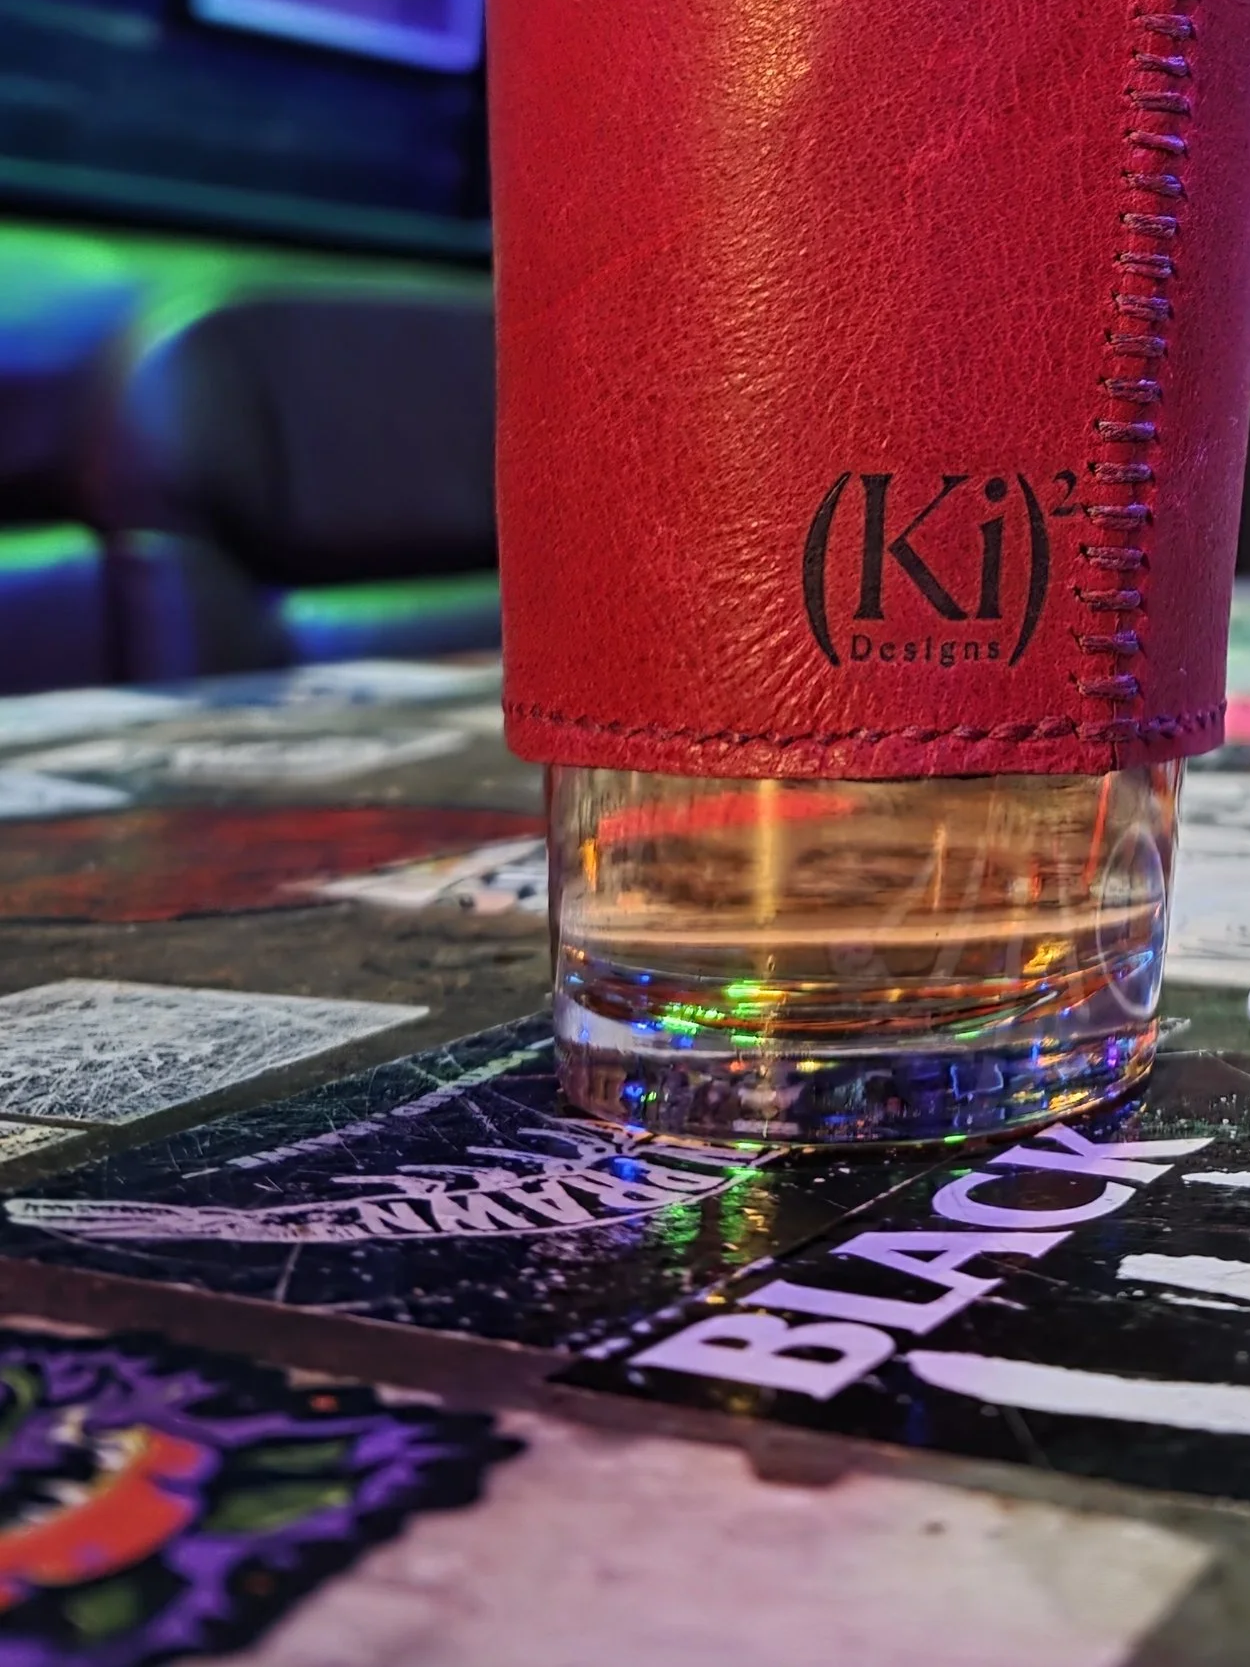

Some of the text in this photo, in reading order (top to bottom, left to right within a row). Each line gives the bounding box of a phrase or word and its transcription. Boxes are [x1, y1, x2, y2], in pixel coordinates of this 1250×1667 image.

[850, 635, 1002, 667] Designs
[358, 1162, 735, 1232] PRAWN
[628, 1123, 1216, 1400] BLACK
